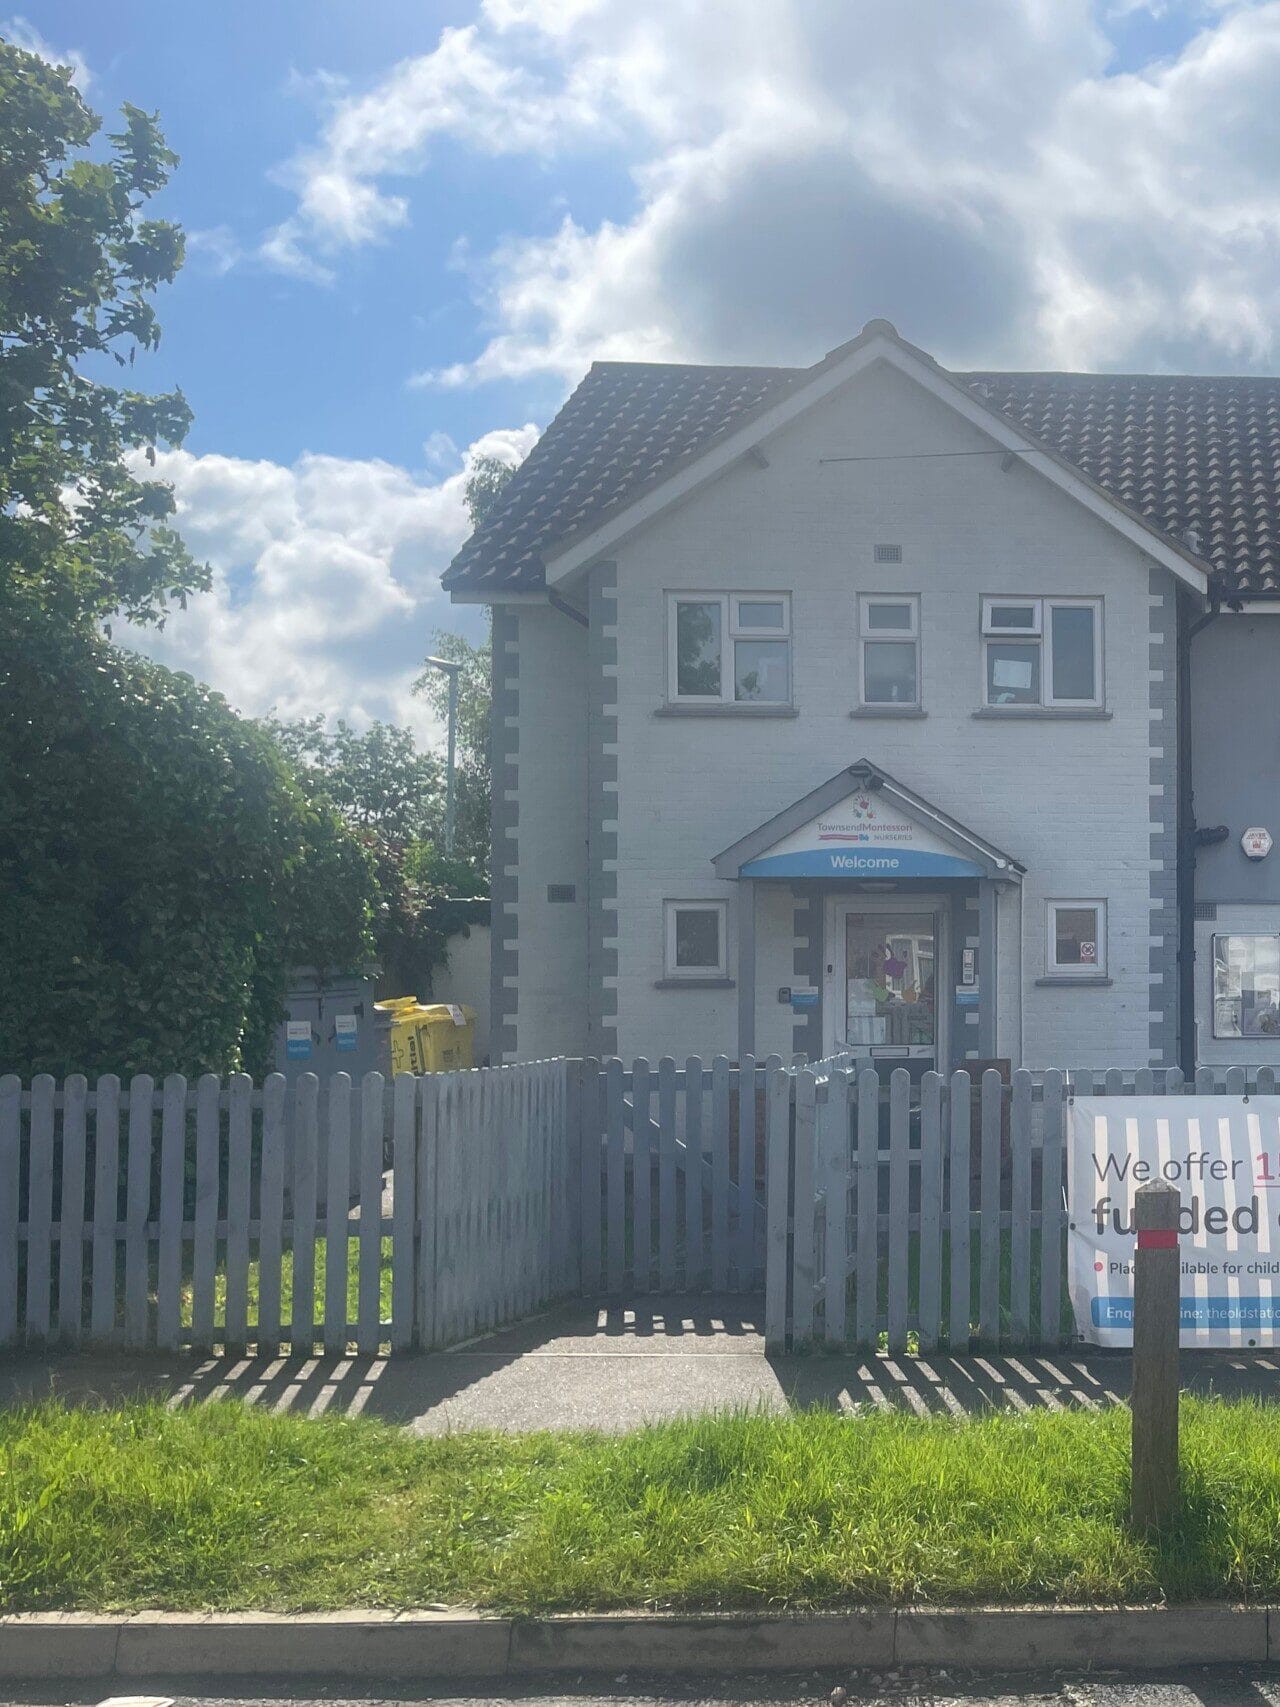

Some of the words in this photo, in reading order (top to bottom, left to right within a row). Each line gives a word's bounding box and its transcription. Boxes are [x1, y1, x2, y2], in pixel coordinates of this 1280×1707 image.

[830, 855, 899, 868] Welcome
[1091, 1153, 1150, 1182] We
[1163, 1152, 1243, 1181] offer
[1091, 1195, 1259, 1235] fuded
[1223, 1262, 1242, 1274] for
